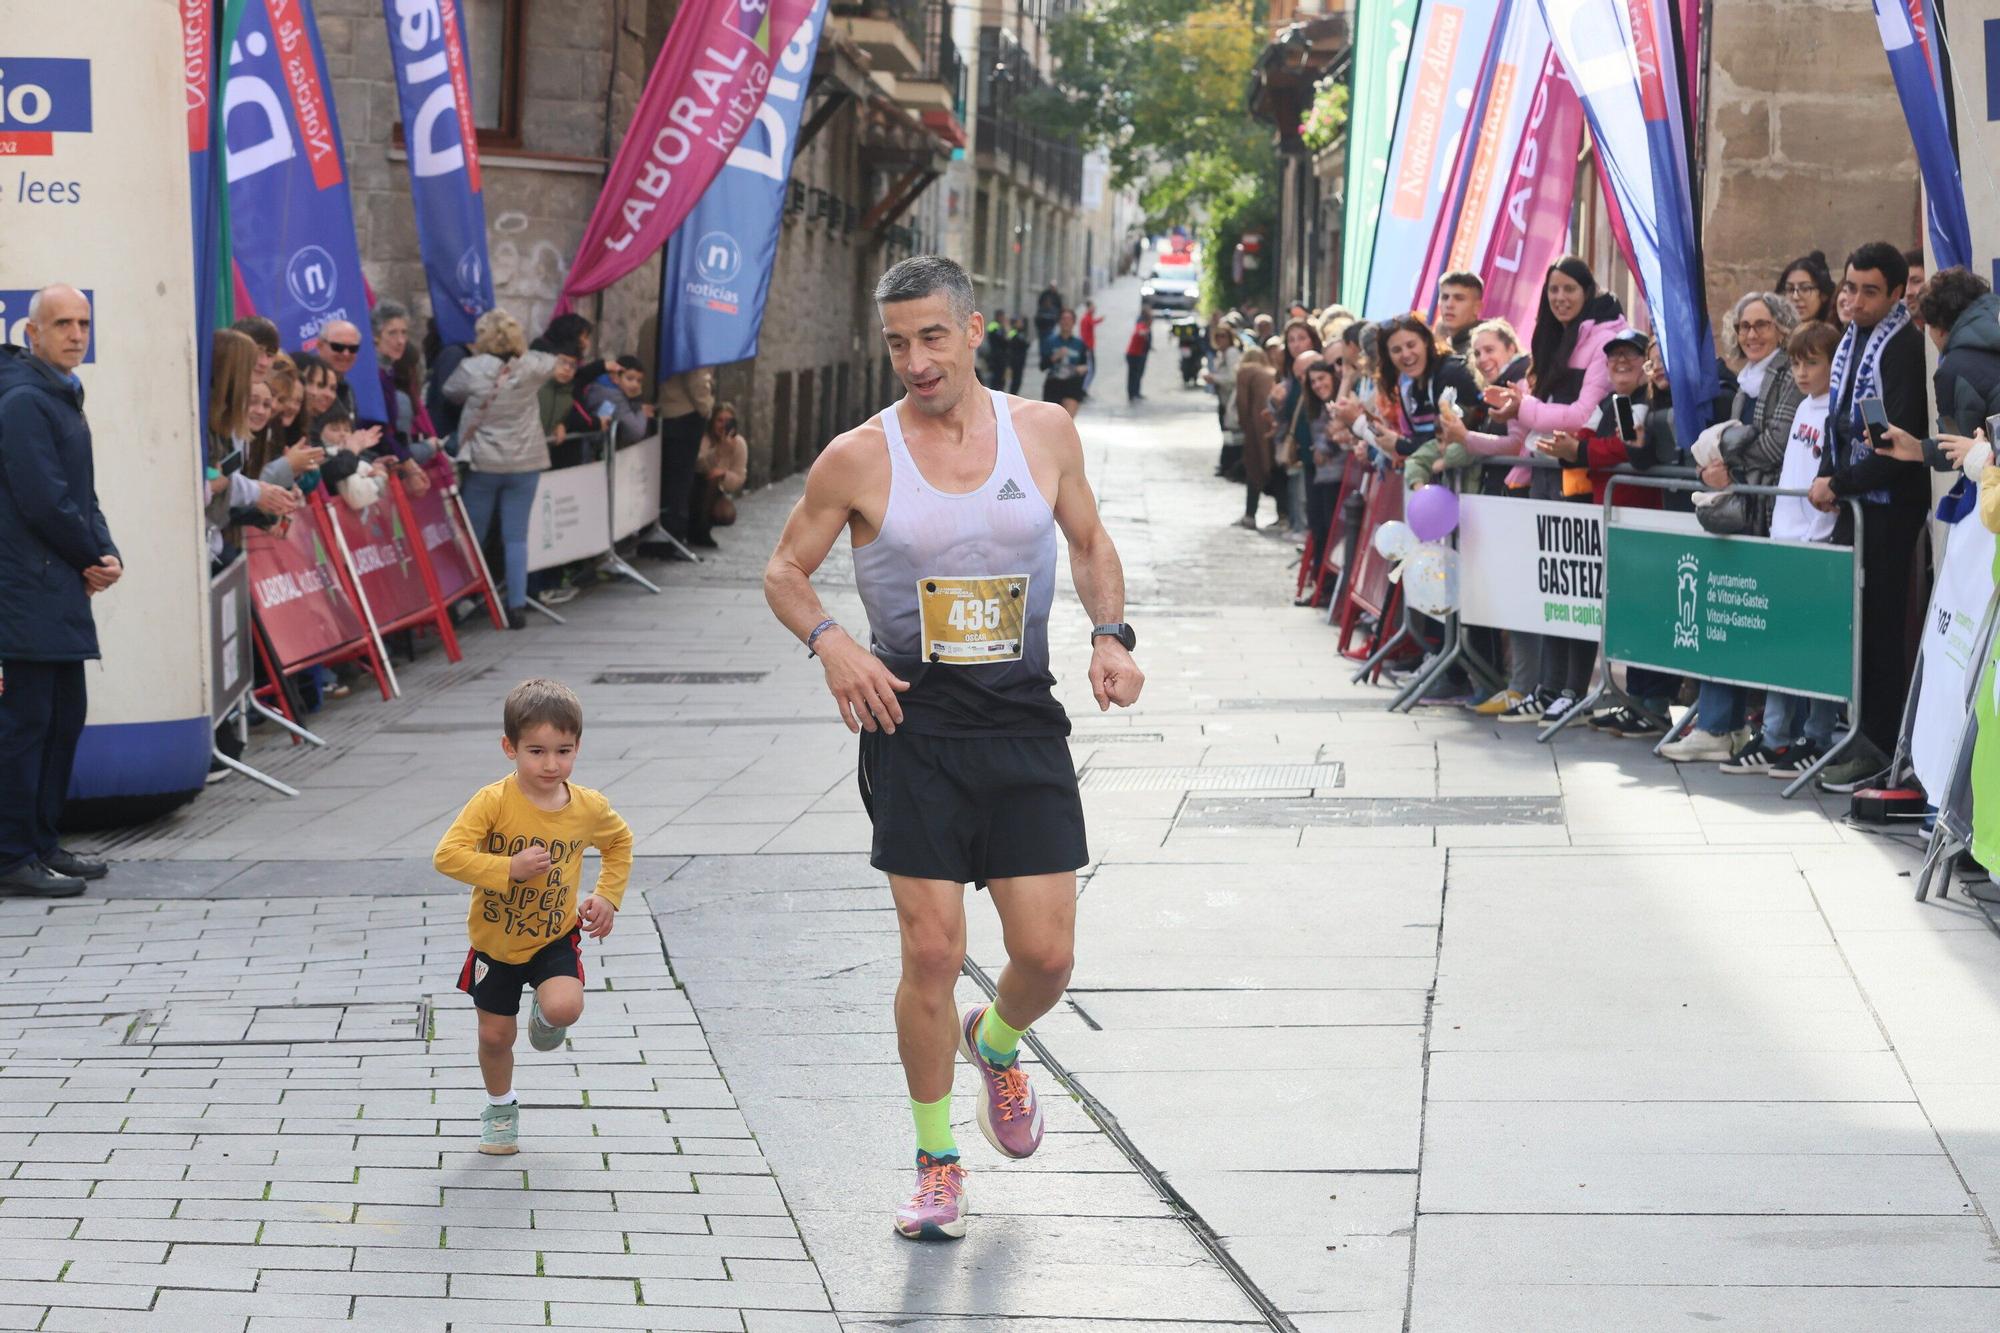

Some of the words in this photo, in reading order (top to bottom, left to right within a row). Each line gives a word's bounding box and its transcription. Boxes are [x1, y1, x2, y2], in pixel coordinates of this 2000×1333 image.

[706, 61, 770, 154] kutxa
[604, 47, 749, 252] LABORAL
[1401, 113, 1435, 198] Noticias
[1421, 82, 1443, 109] de
[18, 171, 81, 204] lees
[686, 282, 739, 304] noticias
[996, 491, 1026, 501] adidas
[1536, 513, 1603, 557] VITORIA
[1537, 556, 1603, 600] GASTEIZ
[1706, 570, 1758, 590] Ayuntamiento
[1707, 587, 1717, 603] de
[1717, 588, 1769, 610] Vitoria-Gasteiz
[947, 597, 1001, 632] 435
[1544, 601, 1571, 622] green
[1705, 607, 1767, 631] Vitoria-Gasteizko
[964, 633, 987, 642] OSCAR
[1705, 625, 1728, 643] Udala
[546, 866, 562, 888] A
